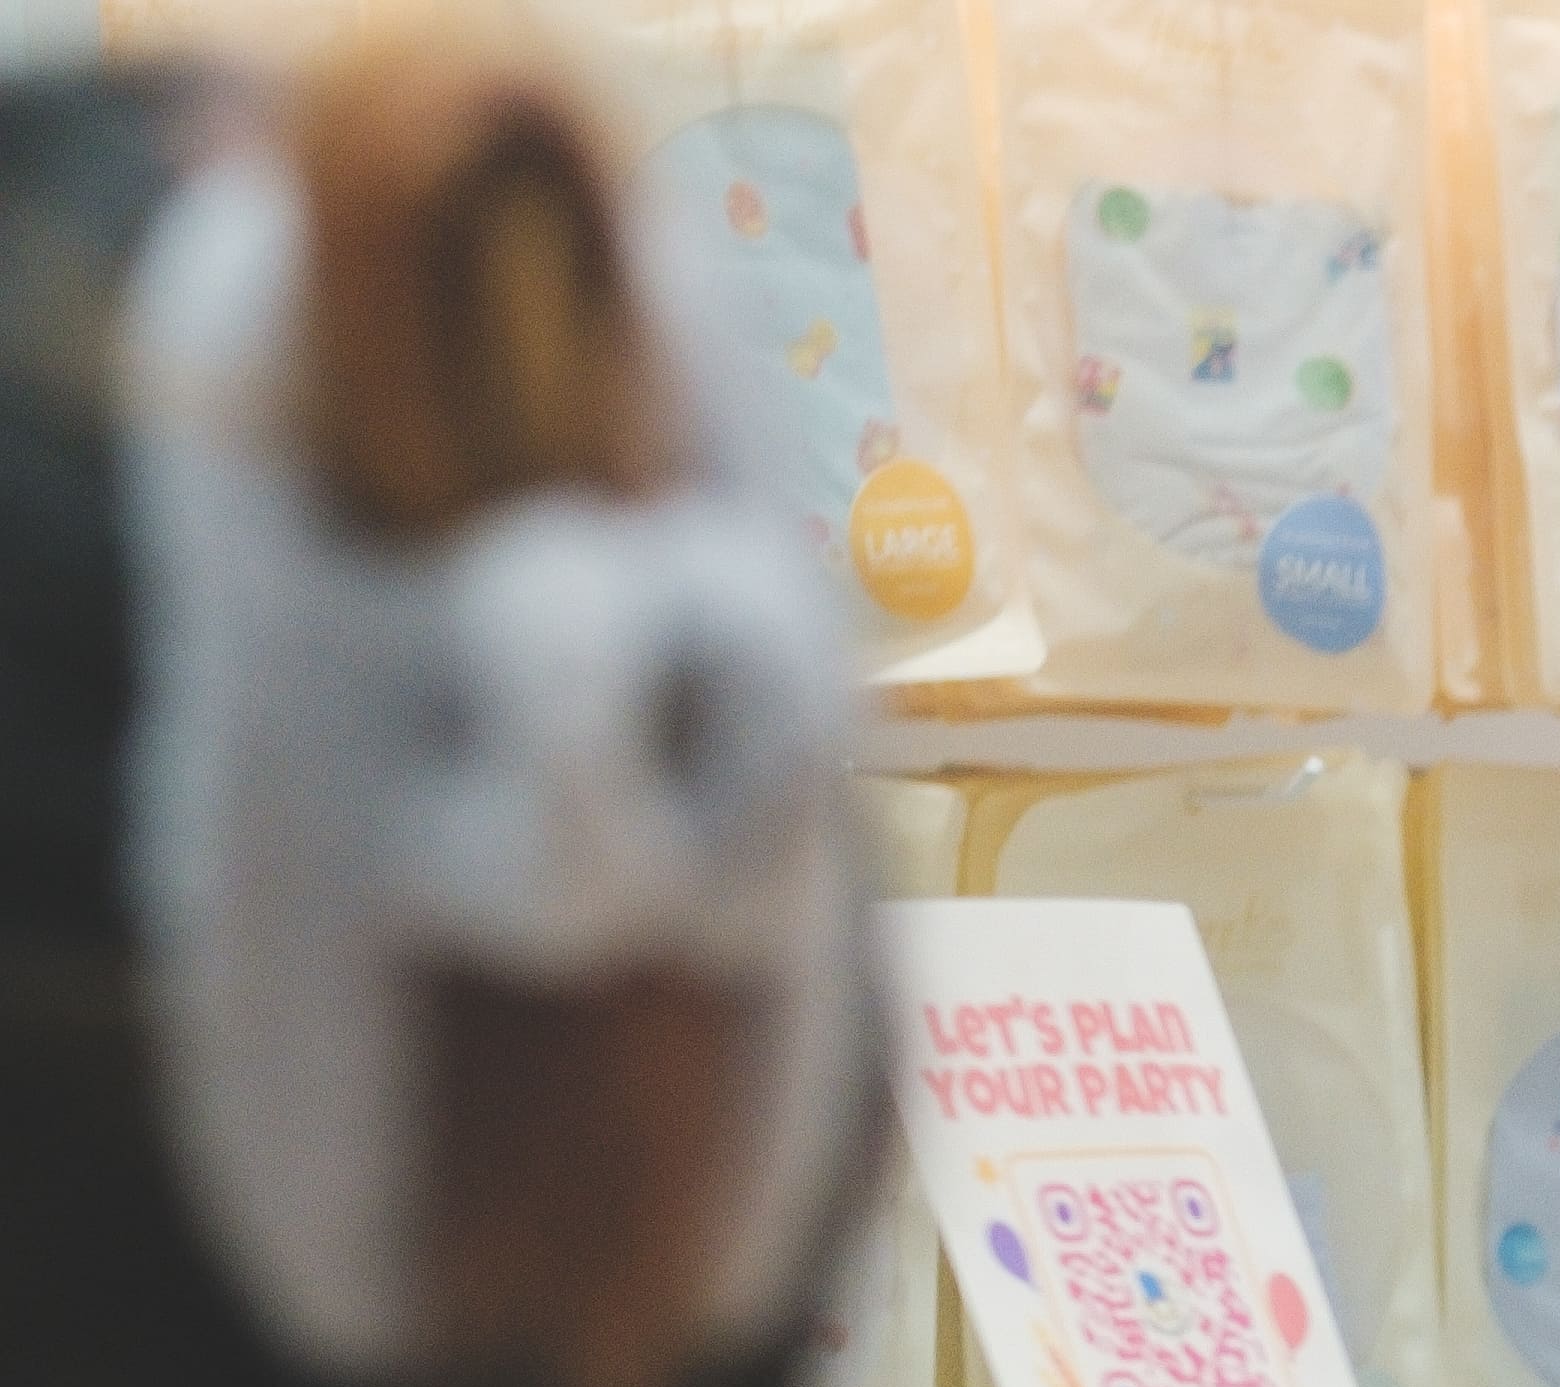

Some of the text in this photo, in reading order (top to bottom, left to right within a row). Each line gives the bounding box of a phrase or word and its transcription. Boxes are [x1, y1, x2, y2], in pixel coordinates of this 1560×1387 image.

[1274, 553, 1370, 604] SMALL
[920, 1061, 1229, 1122] YOUR PARTY
